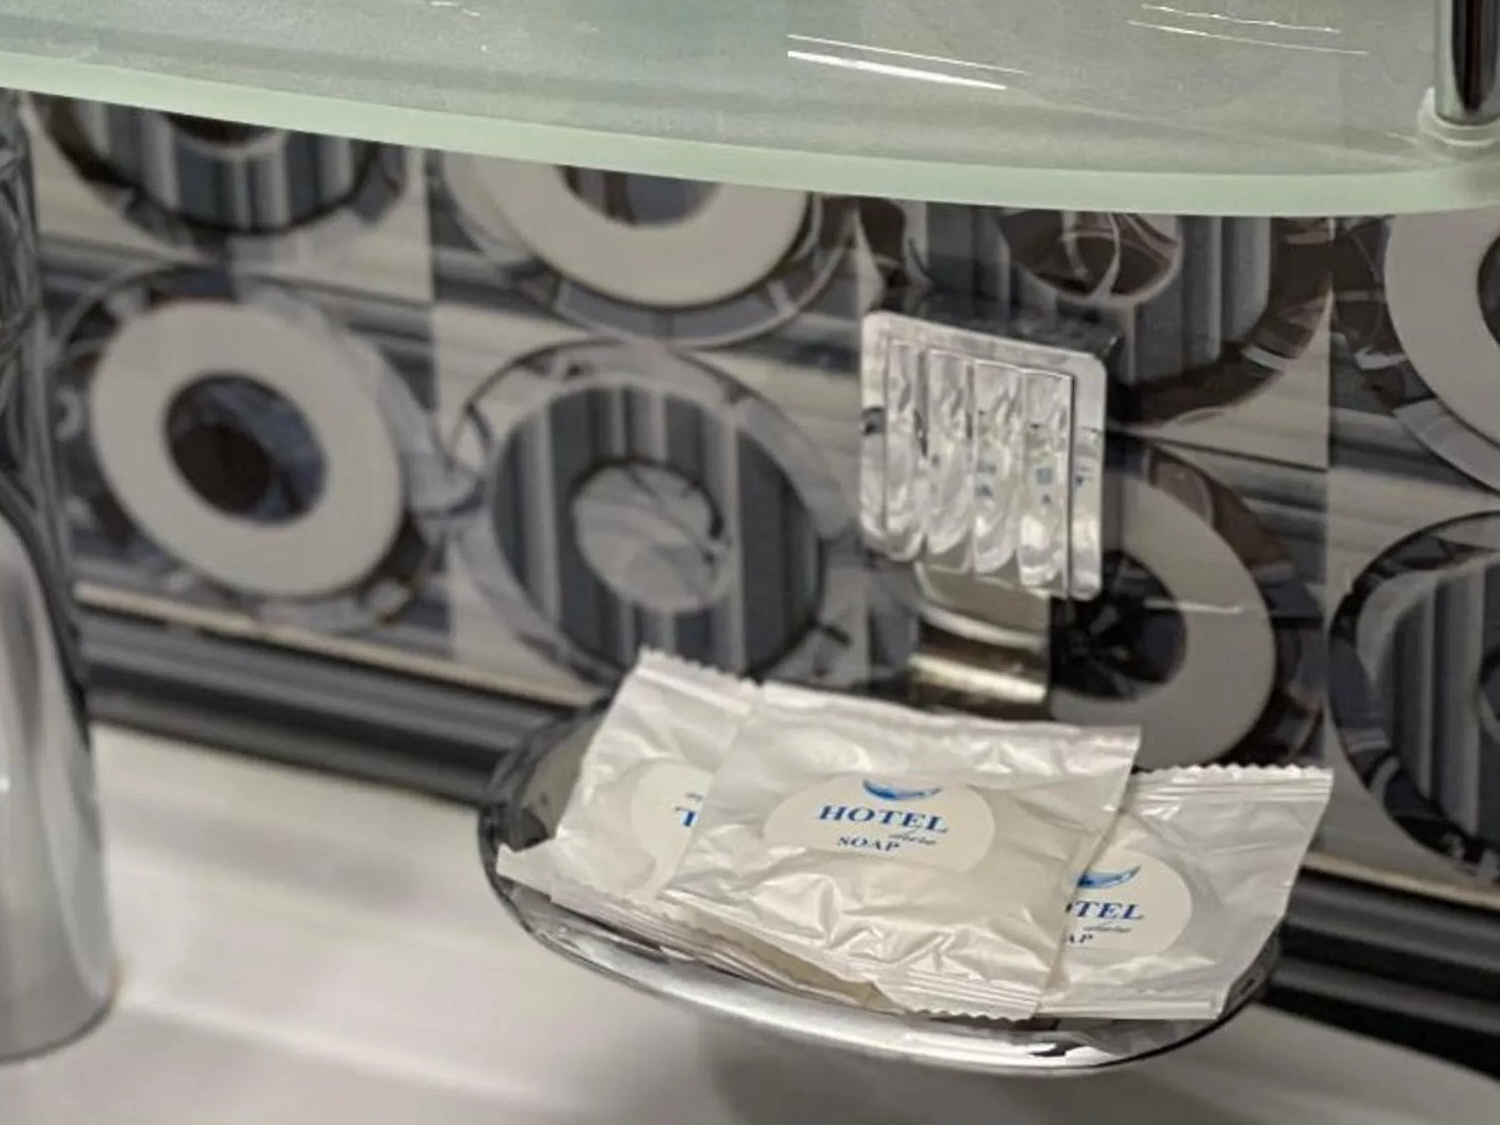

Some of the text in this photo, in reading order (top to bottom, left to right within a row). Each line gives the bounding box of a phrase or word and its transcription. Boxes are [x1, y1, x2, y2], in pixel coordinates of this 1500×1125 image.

[818, 804, 949, 833] HOTEL
[836, 835, 900, 852] SOAP
[1065, 900, 1144, 919] TEL
[1068, 933, 1094, 944] AP
